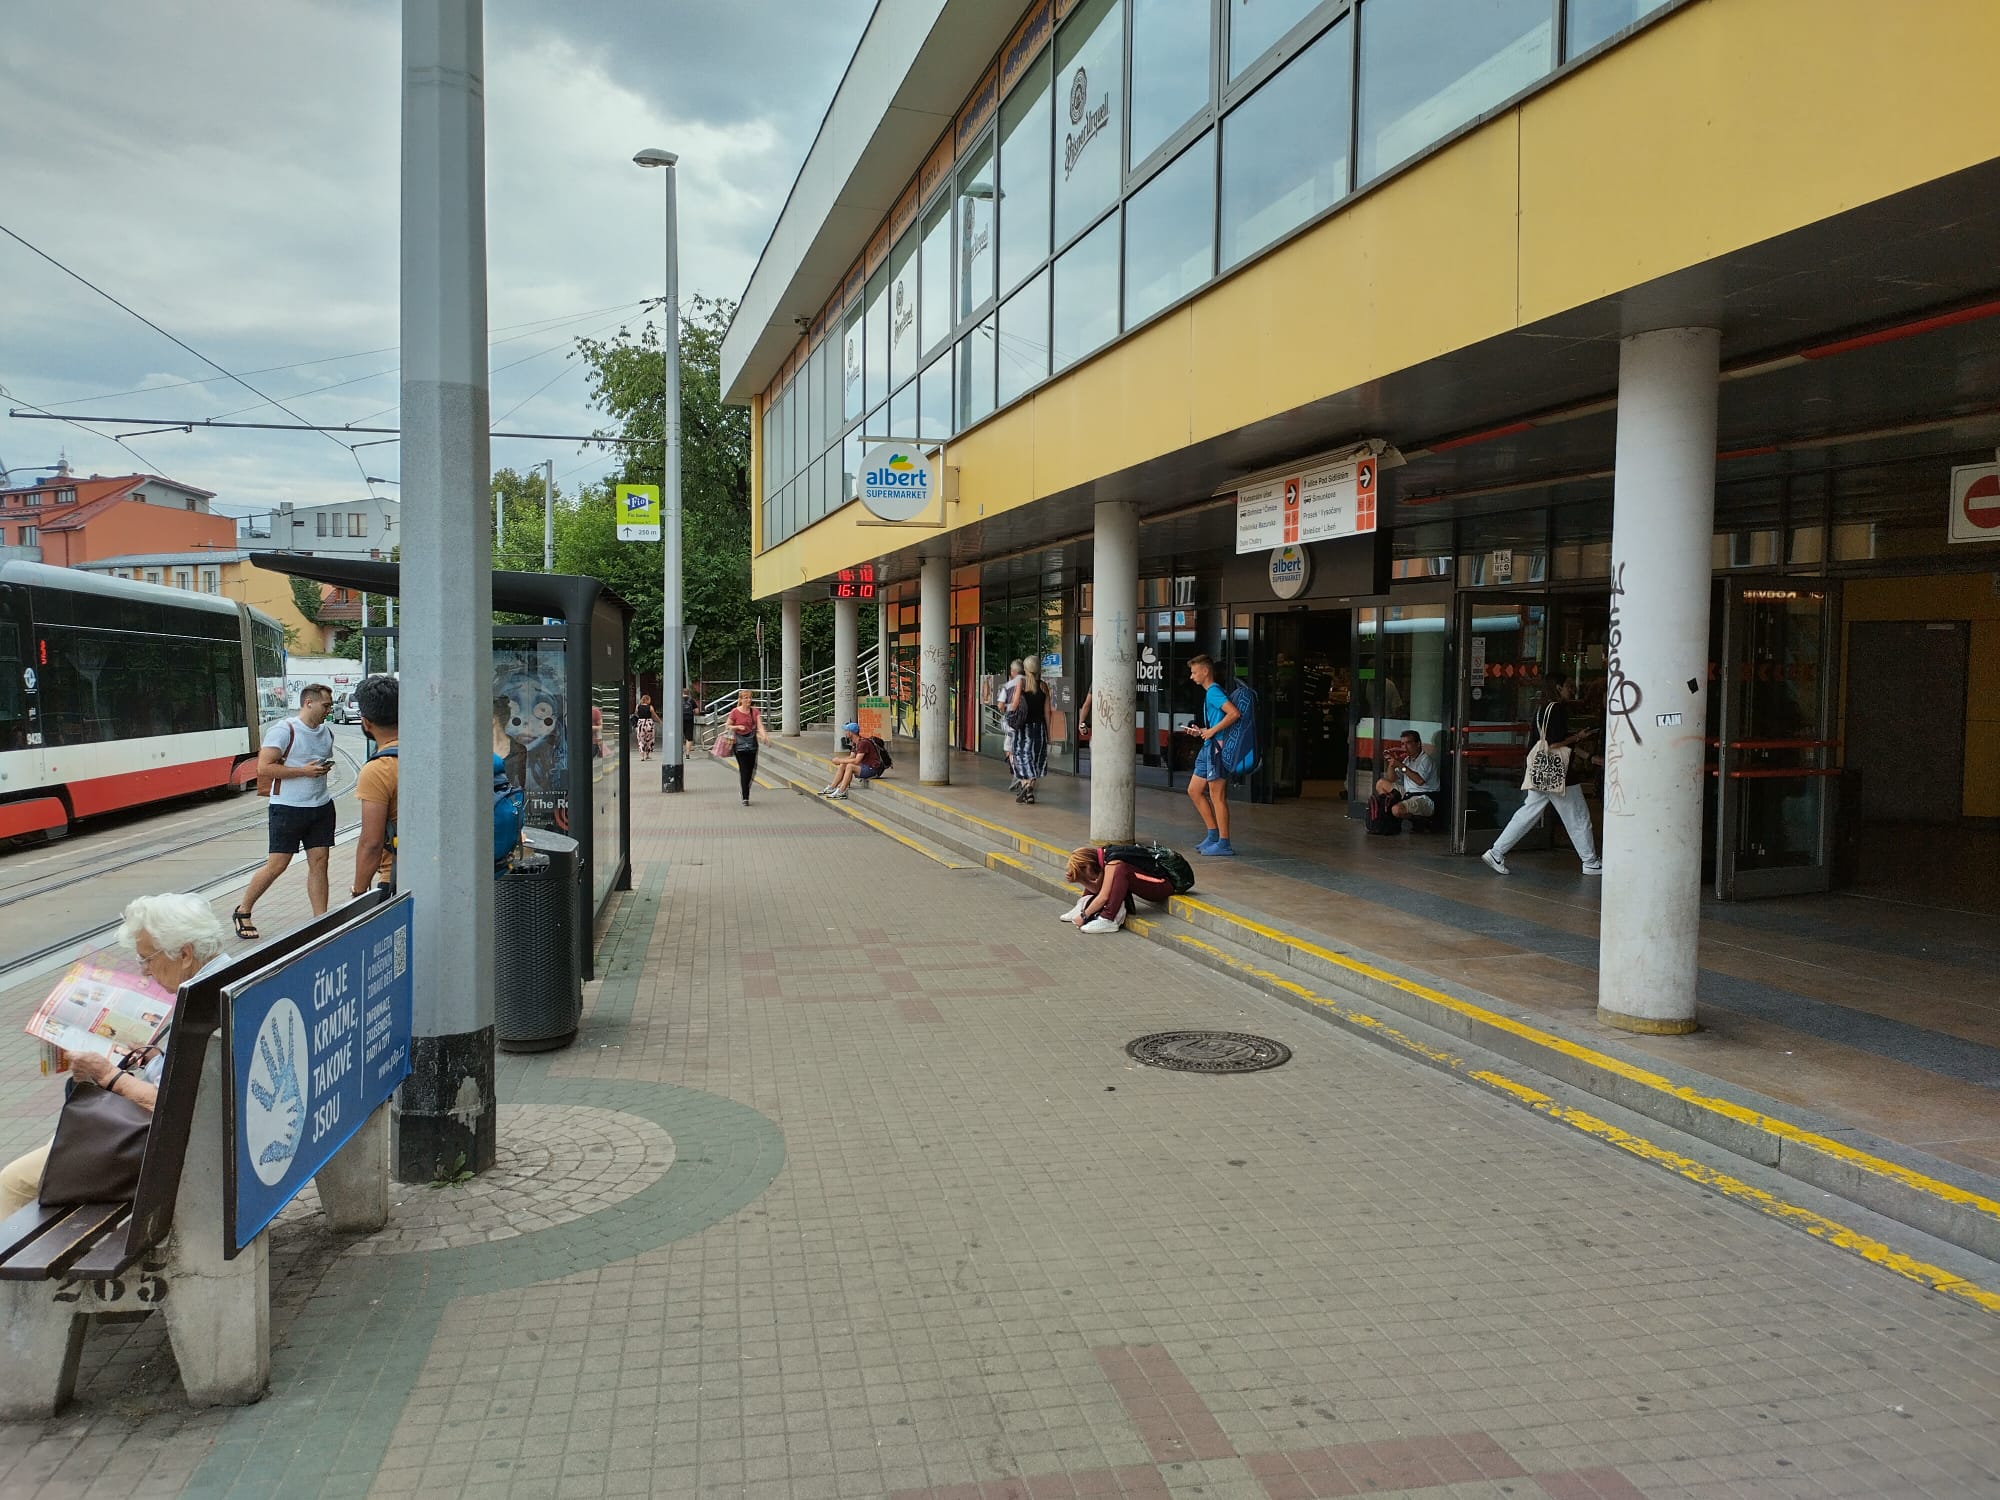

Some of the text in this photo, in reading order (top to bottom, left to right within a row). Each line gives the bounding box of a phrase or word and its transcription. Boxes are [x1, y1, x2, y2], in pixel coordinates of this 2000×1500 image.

[1064, 91, 1109, 182] Pilsner Urquell
[866, 468, 927, 486] albert
[631, 496, 646, 508] Fio
[866, 489, 927, 500] SUPERMARKET
[1272, 556, 1302, 573] albert
[838, 584, 873, 597] 16:10
[1136, 660, 1163, 680] lbert
[532, 798, 554, 809] The
[314, 962, 348, 1011] ČÍM JE
[314, 997, 359, 1056] KRMÍME,
[314, 1033, 352, 1099] TAKOVÉ
[312, 1092, 340, 1144] JSOU
